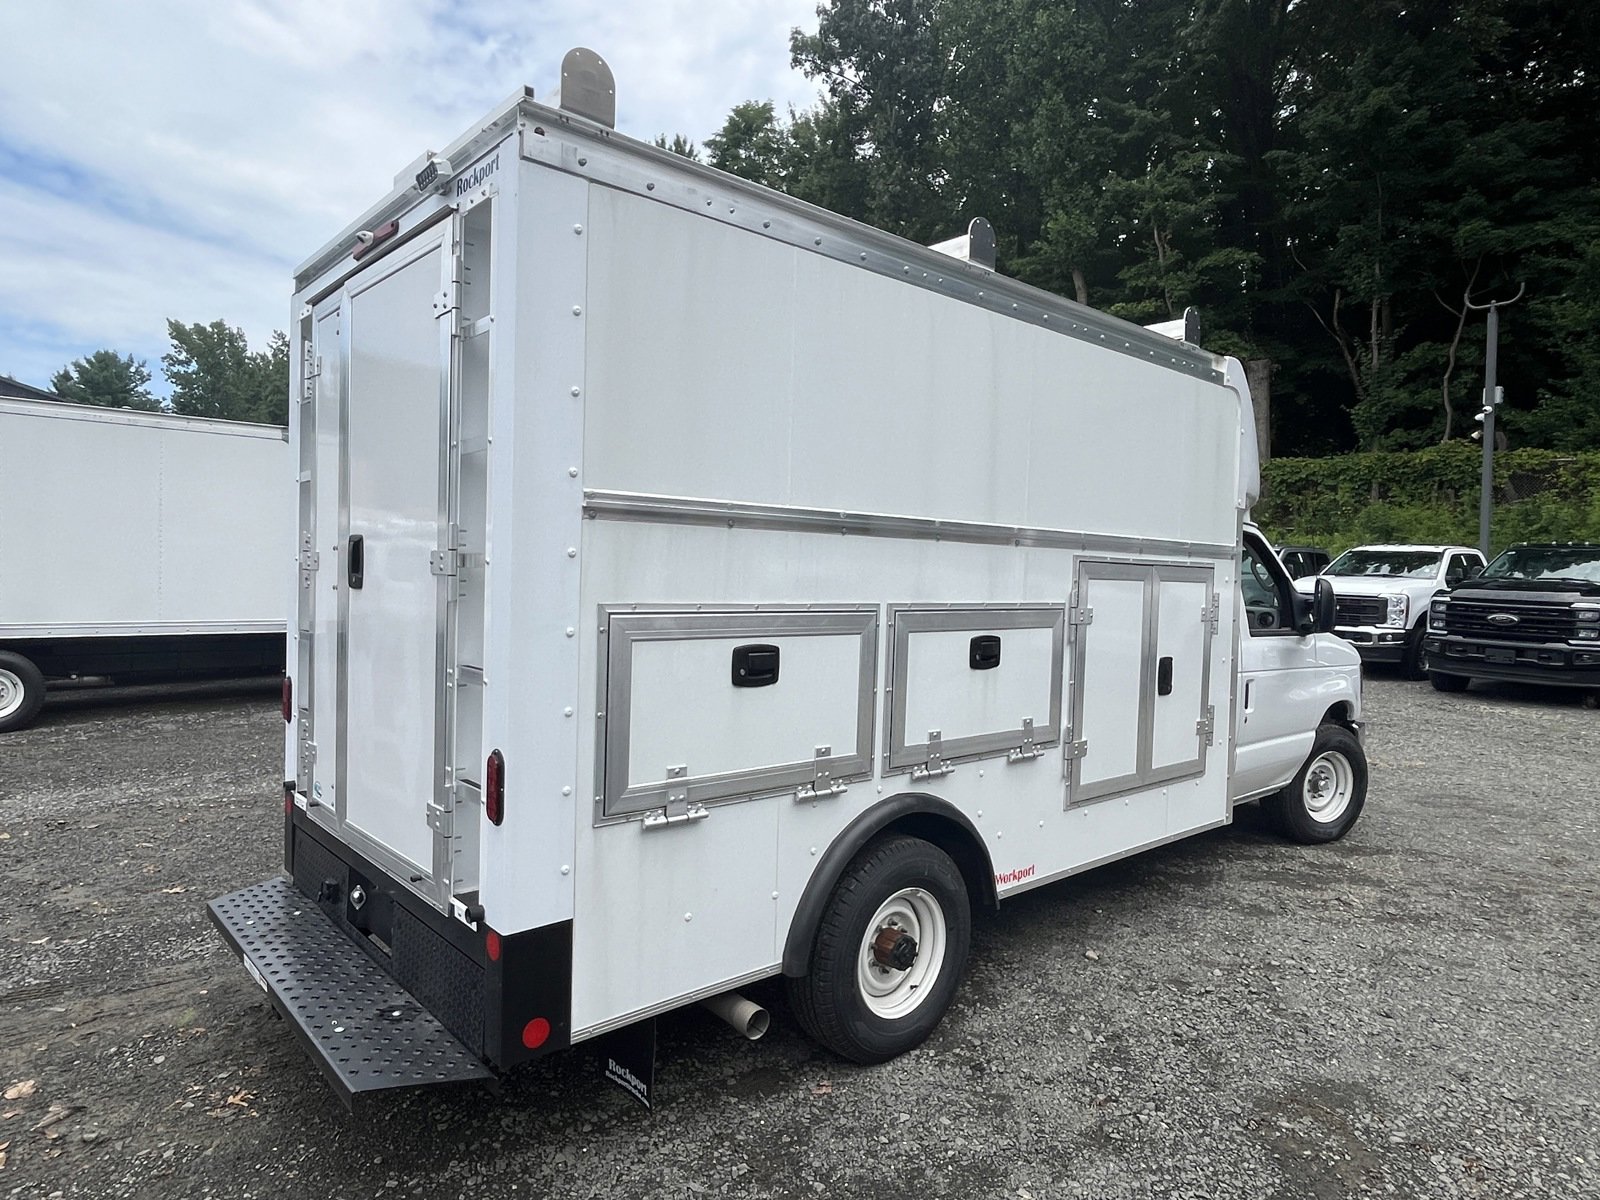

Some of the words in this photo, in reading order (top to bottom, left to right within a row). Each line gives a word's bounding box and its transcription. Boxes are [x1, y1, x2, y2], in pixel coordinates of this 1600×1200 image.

[457, 152, 499, 197] Rockport
[995, 864, 1035, 885] Workport
[608, 1058, 647, 1096] Rockport
